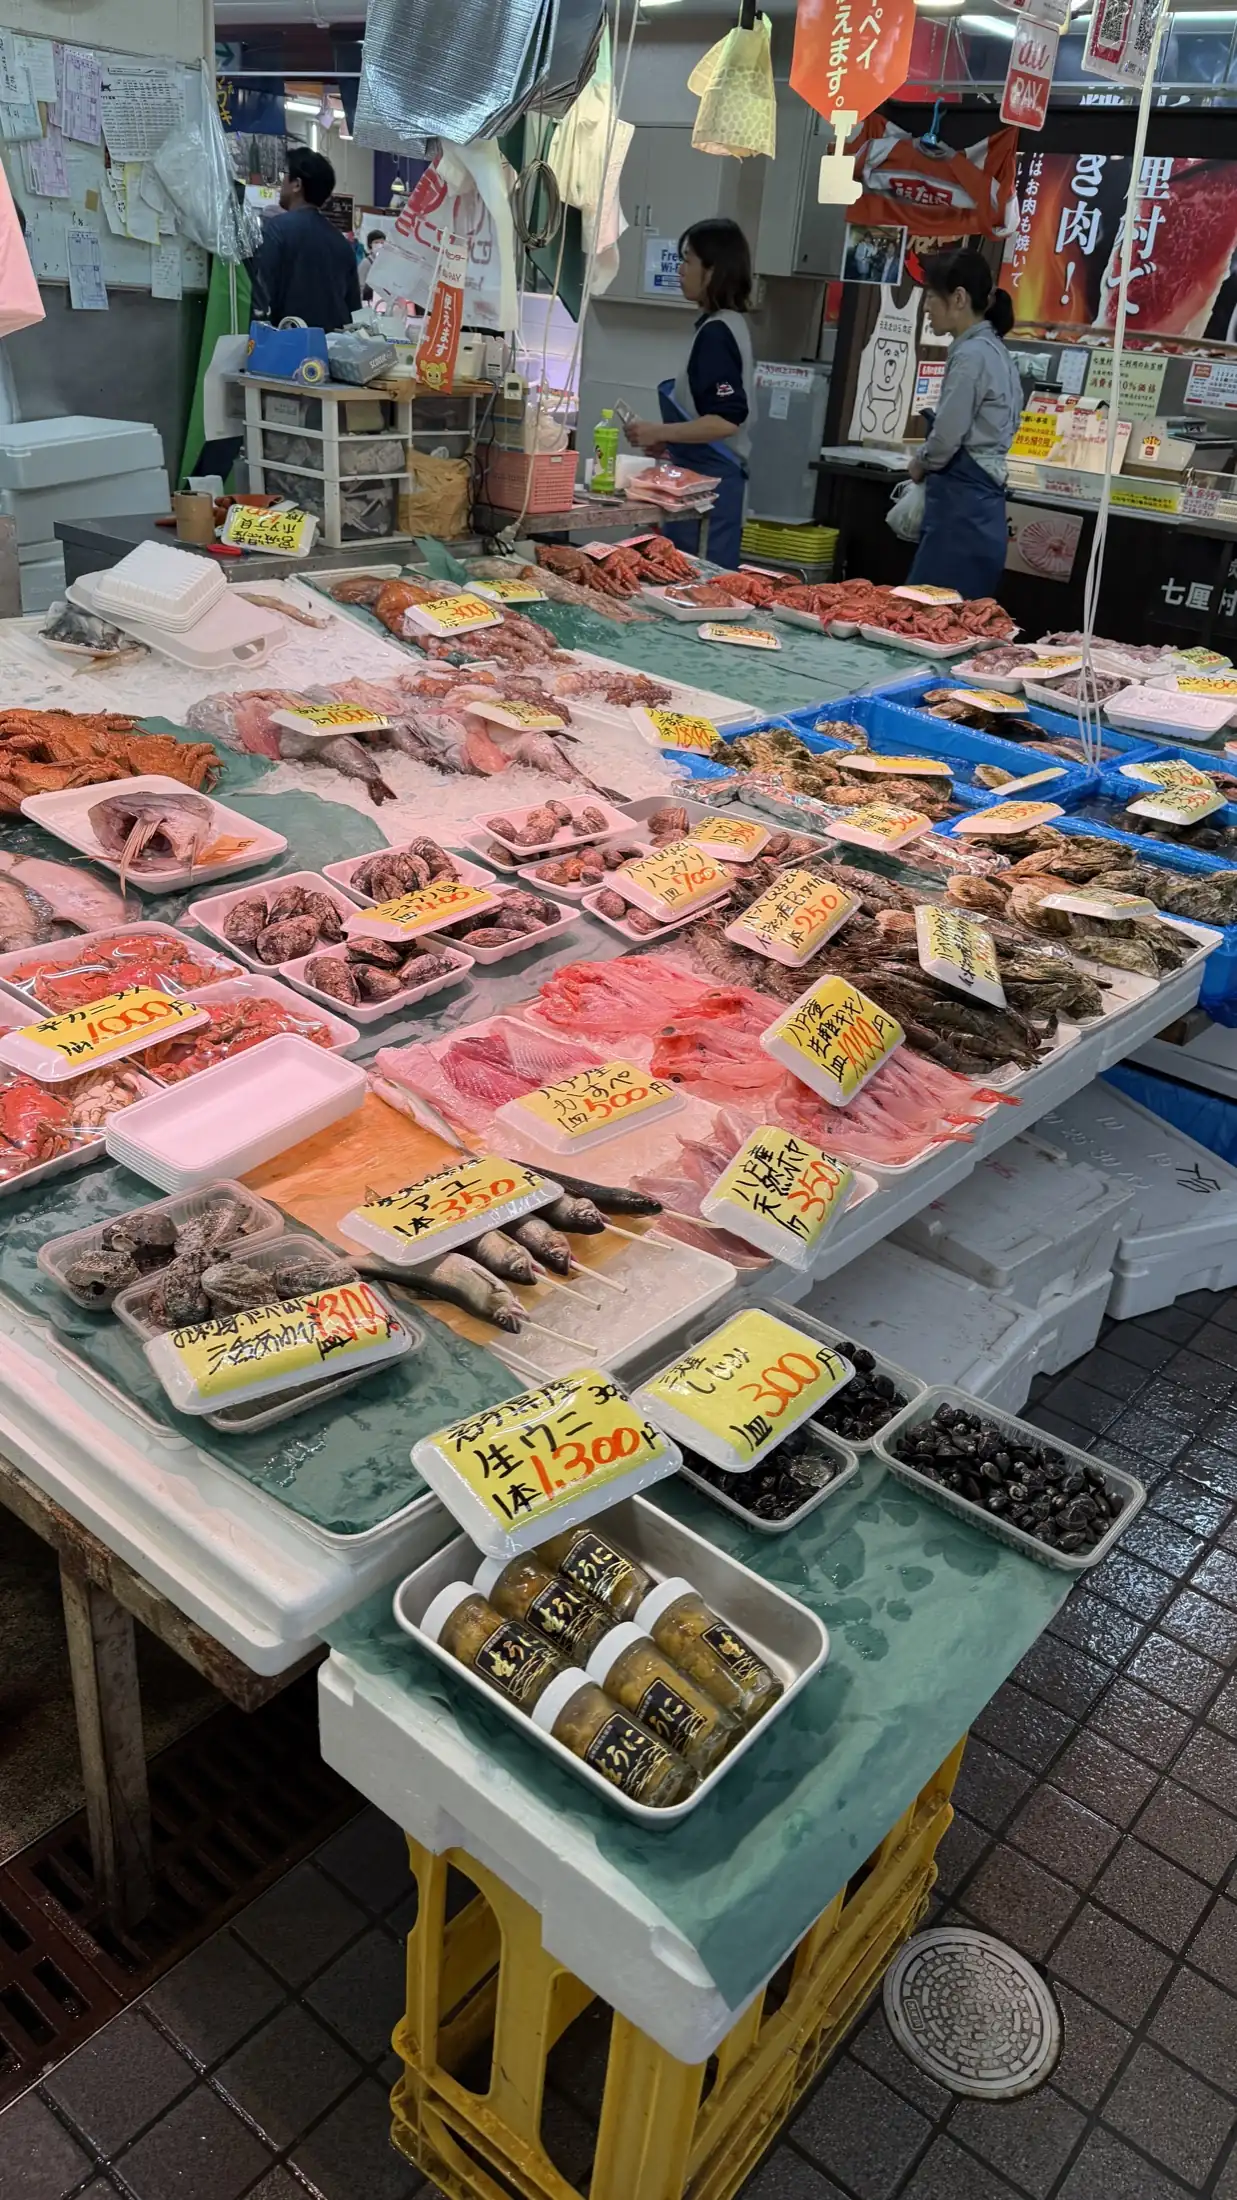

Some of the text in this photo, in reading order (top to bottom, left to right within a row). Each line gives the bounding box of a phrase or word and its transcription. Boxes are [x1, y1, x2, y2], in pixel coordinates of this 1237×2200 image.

[826, 0, 853, 108] えます。
[1018, 40, 1050, 72] au
[1014, 76, 1043, 110] PAY
[1011, 153, 1045, 288] はお肉も焼いて
[661, 262, 681, 273] Wi-F
[646, 852, 705, 888] ハマグリ
[672, 866, 717, 893] 700
[414, 891, 470, 912] 400
[794, 894, 838, 934] 250
[582, 1086, 648, 1119] 500
[648, 1080, 675, 1096] 円
[397, 1178, 483, 1212] アユ
[430, 1178, 516, 1223] 350
[786, 1160, 841, 1222] 350
[685, 1347, 751, 1394] しじみ
[737, 1352, 821, 1418] 300
[816, 1347, 847, 1381] 円
[474, 1411, 594, 1480] 生ウニ
